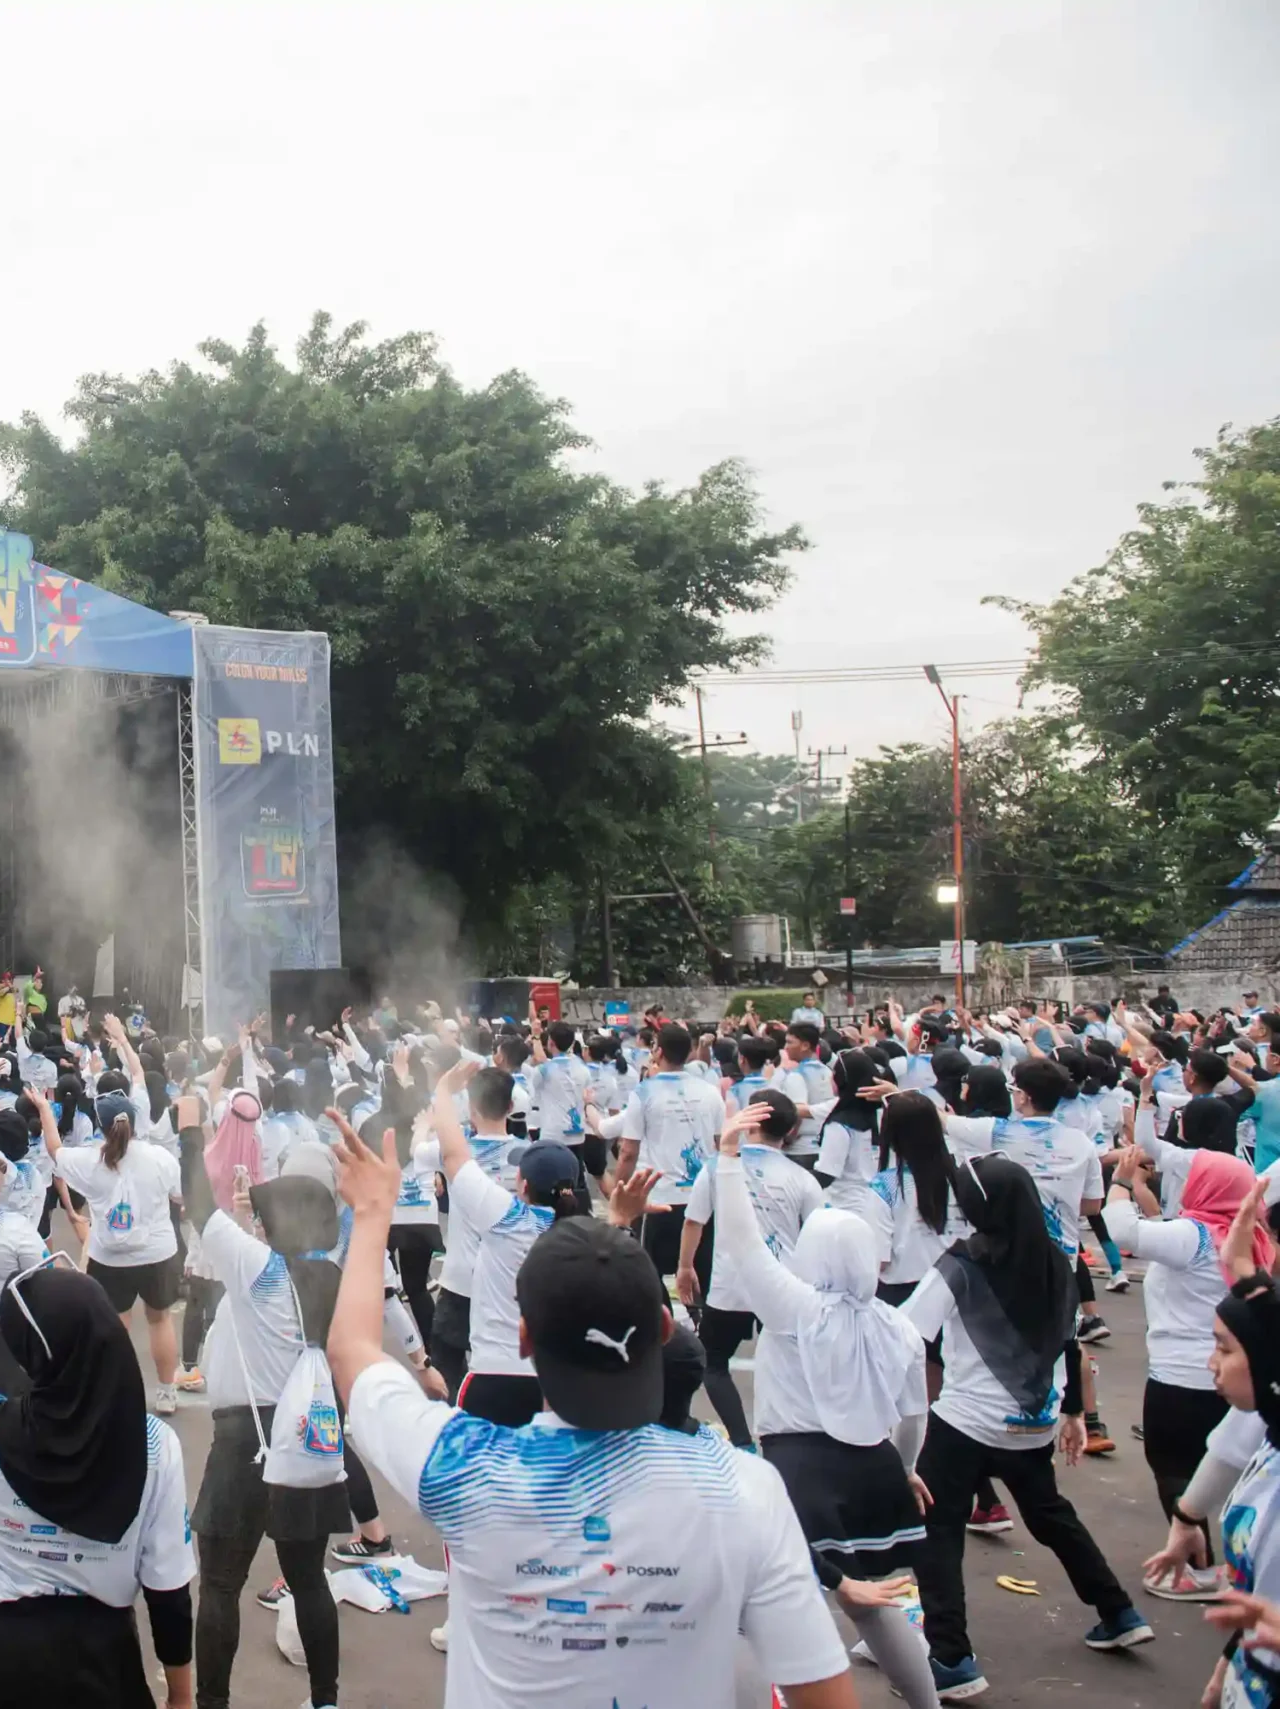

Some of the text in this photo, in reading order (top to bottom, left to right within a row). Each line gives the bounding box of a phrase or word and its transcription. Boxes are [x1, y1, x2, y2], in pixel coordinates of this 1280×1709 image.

[266, 730, 320, 757] PLN
[515, 1562, 680, 1577] ICONNET POSPAY
